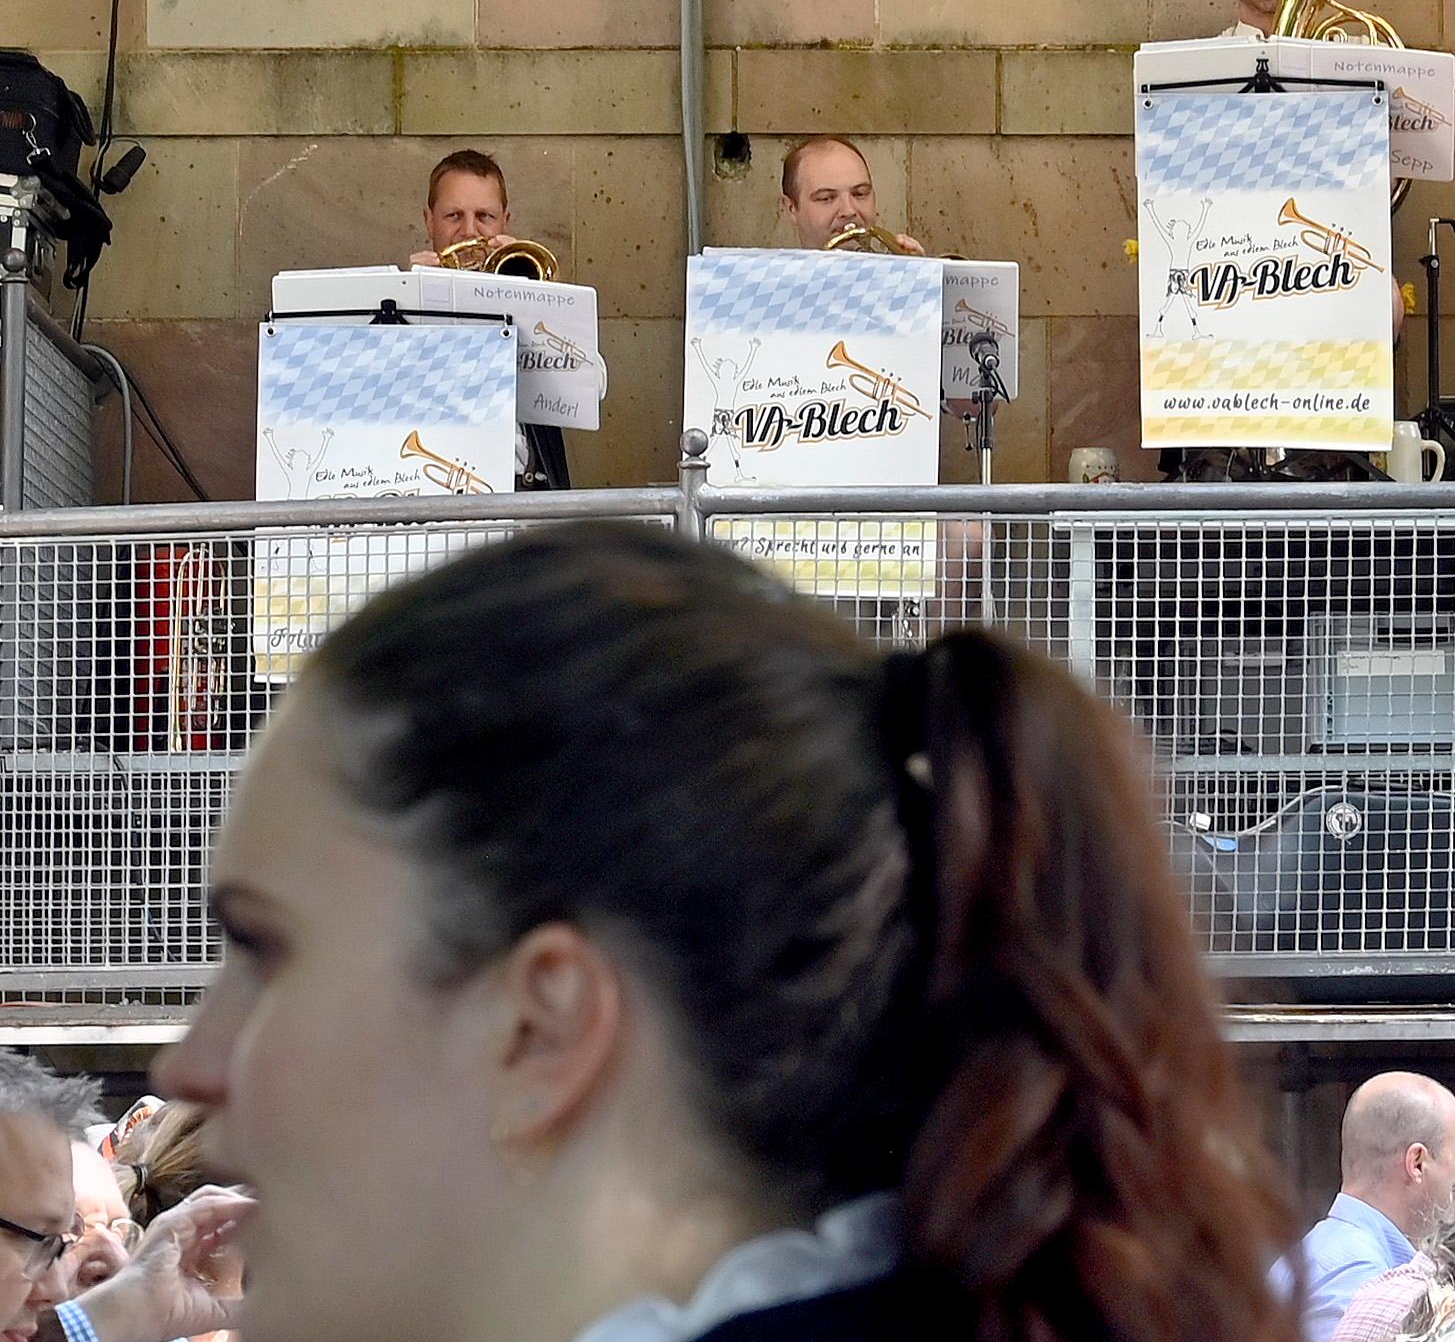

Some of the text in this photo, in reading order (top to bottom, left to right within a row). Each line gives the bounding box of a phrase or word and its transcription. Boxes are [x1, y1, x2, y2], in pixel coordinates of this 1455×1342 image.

[1333, 60, 1436, 78] Notenmappe
[1390, 149, 1434, 173] Sepp
[945, 274, 1000, 288] mappe
[473, 285, 576, 307] Notenmappe
[532, 393, 580, 419] Anderl
[1163, 393, 1371, 412] www.vablech-online.de
